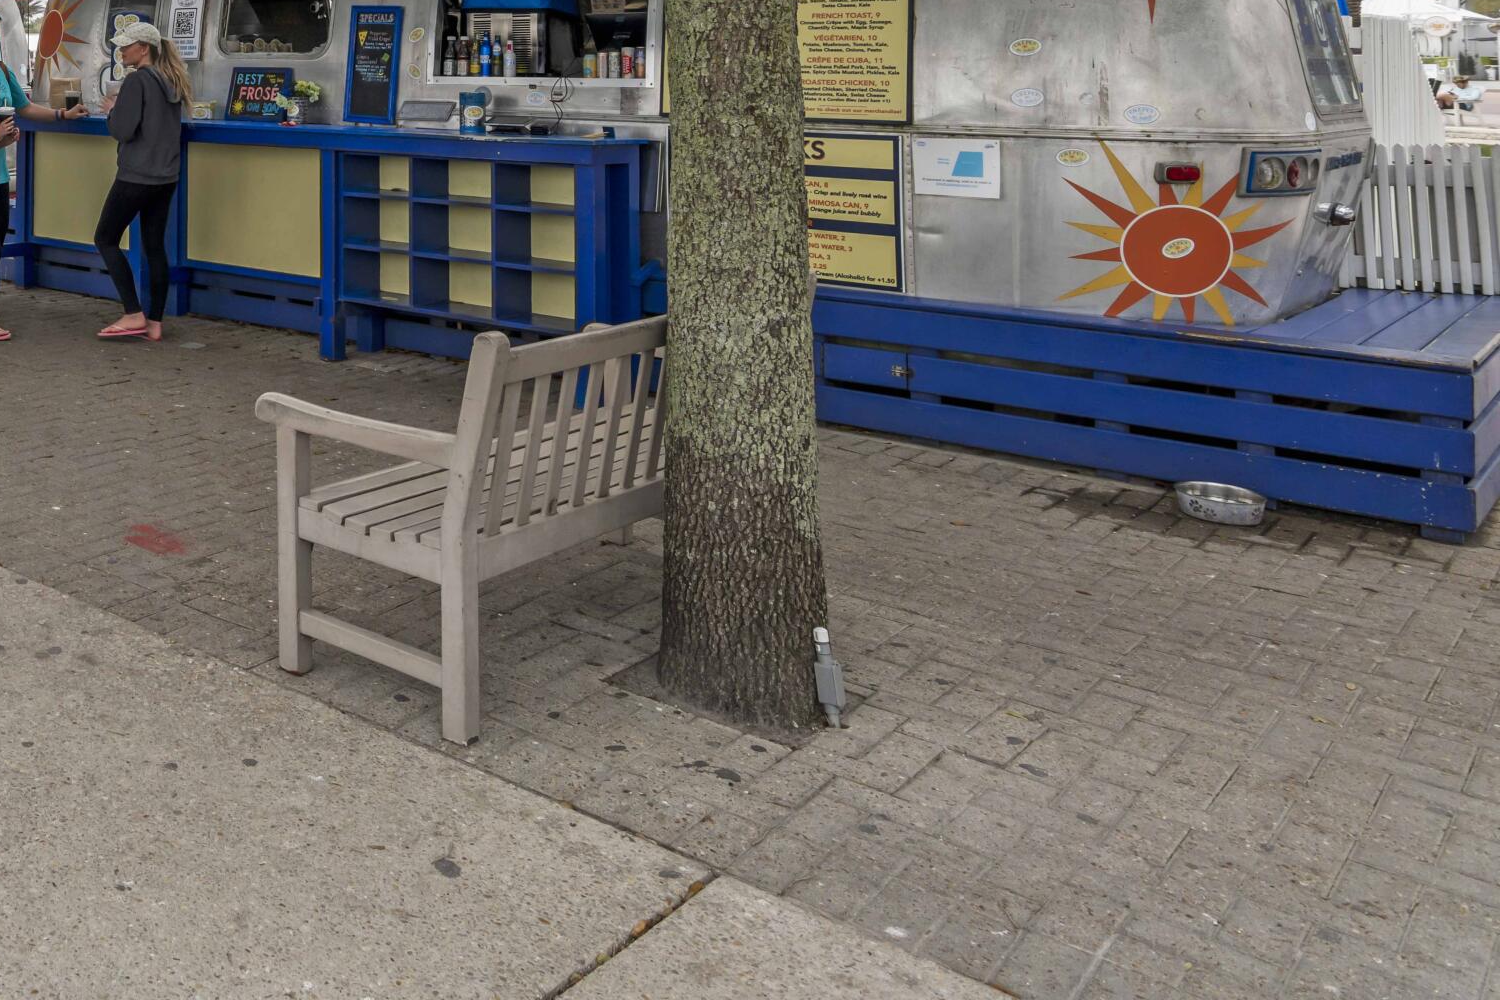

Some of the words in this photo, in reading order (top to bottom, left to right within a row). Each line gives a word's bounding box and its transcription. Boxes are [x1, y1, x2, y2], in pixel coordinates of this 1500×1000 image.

[237, 73, 264, 85] BEST
[809, 199, 840, 207] MIMOSA
[842, 201, 862, 209] CAN,
[809, 252, 825, 260] OLA,
